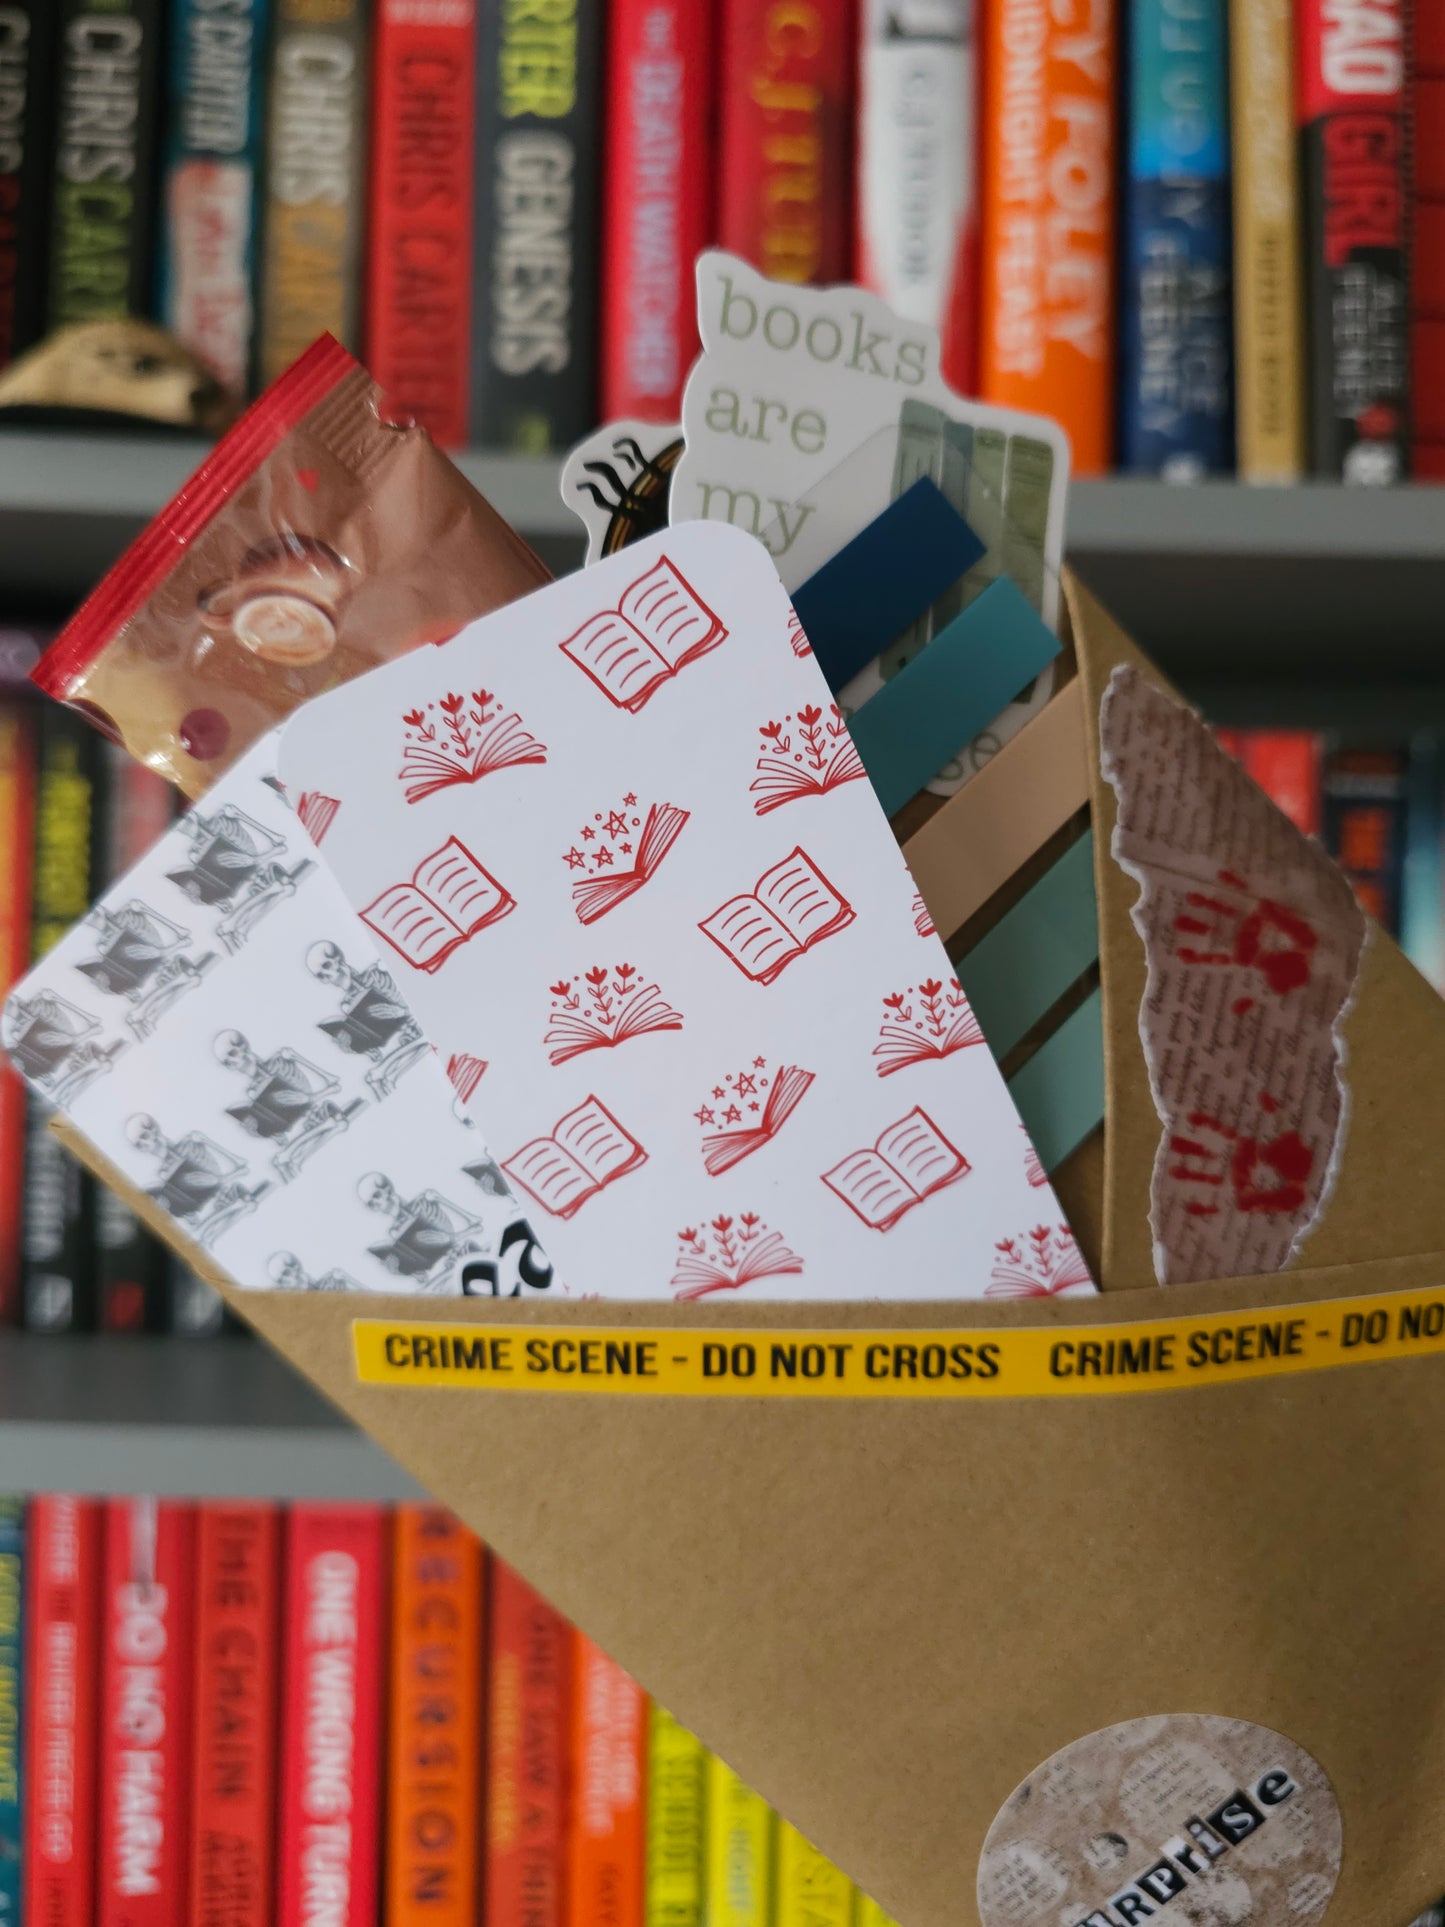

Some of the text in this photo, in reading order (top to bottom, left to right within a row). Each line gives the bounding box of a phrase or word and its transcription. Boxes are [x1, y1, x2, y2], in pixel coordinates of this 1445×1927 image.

[57, 16, 142, 182] CHRIS
[268, 32, 355, 207] CHRIS
[396, 54, 461, 208] CHRIS
[1319, 0, 1403, 268] AD GIRL
[493, 130, 576, 376] GENESIS
[718, 274, 928, 386] books
[704, 386, 828, 455] are
[696, 480, 817, 558] my
[384, 1333, 514, 1372] CRIME
[526, 1337, 659, 1377] SCENE
[702, 1343, 757, 1378] DO
[770, 1344, 853, 1379] NOT
[865, 1343, 1002, 1380] CROSS
[1049, 1335, 1176, 1378] CRIME
[1185, 1320, 1306, 1368] SCENE
[1339, 1309, 1390, 1349] DO
[306, 1550, 359, 1645] ONE
[210, 1627, 259, 1800] CHAIN
[302, 1647, 356, 1819] WRONG
[411, 1508, 460, 1905] RECURSION
[113, 1749, 165, 1896] HARM
